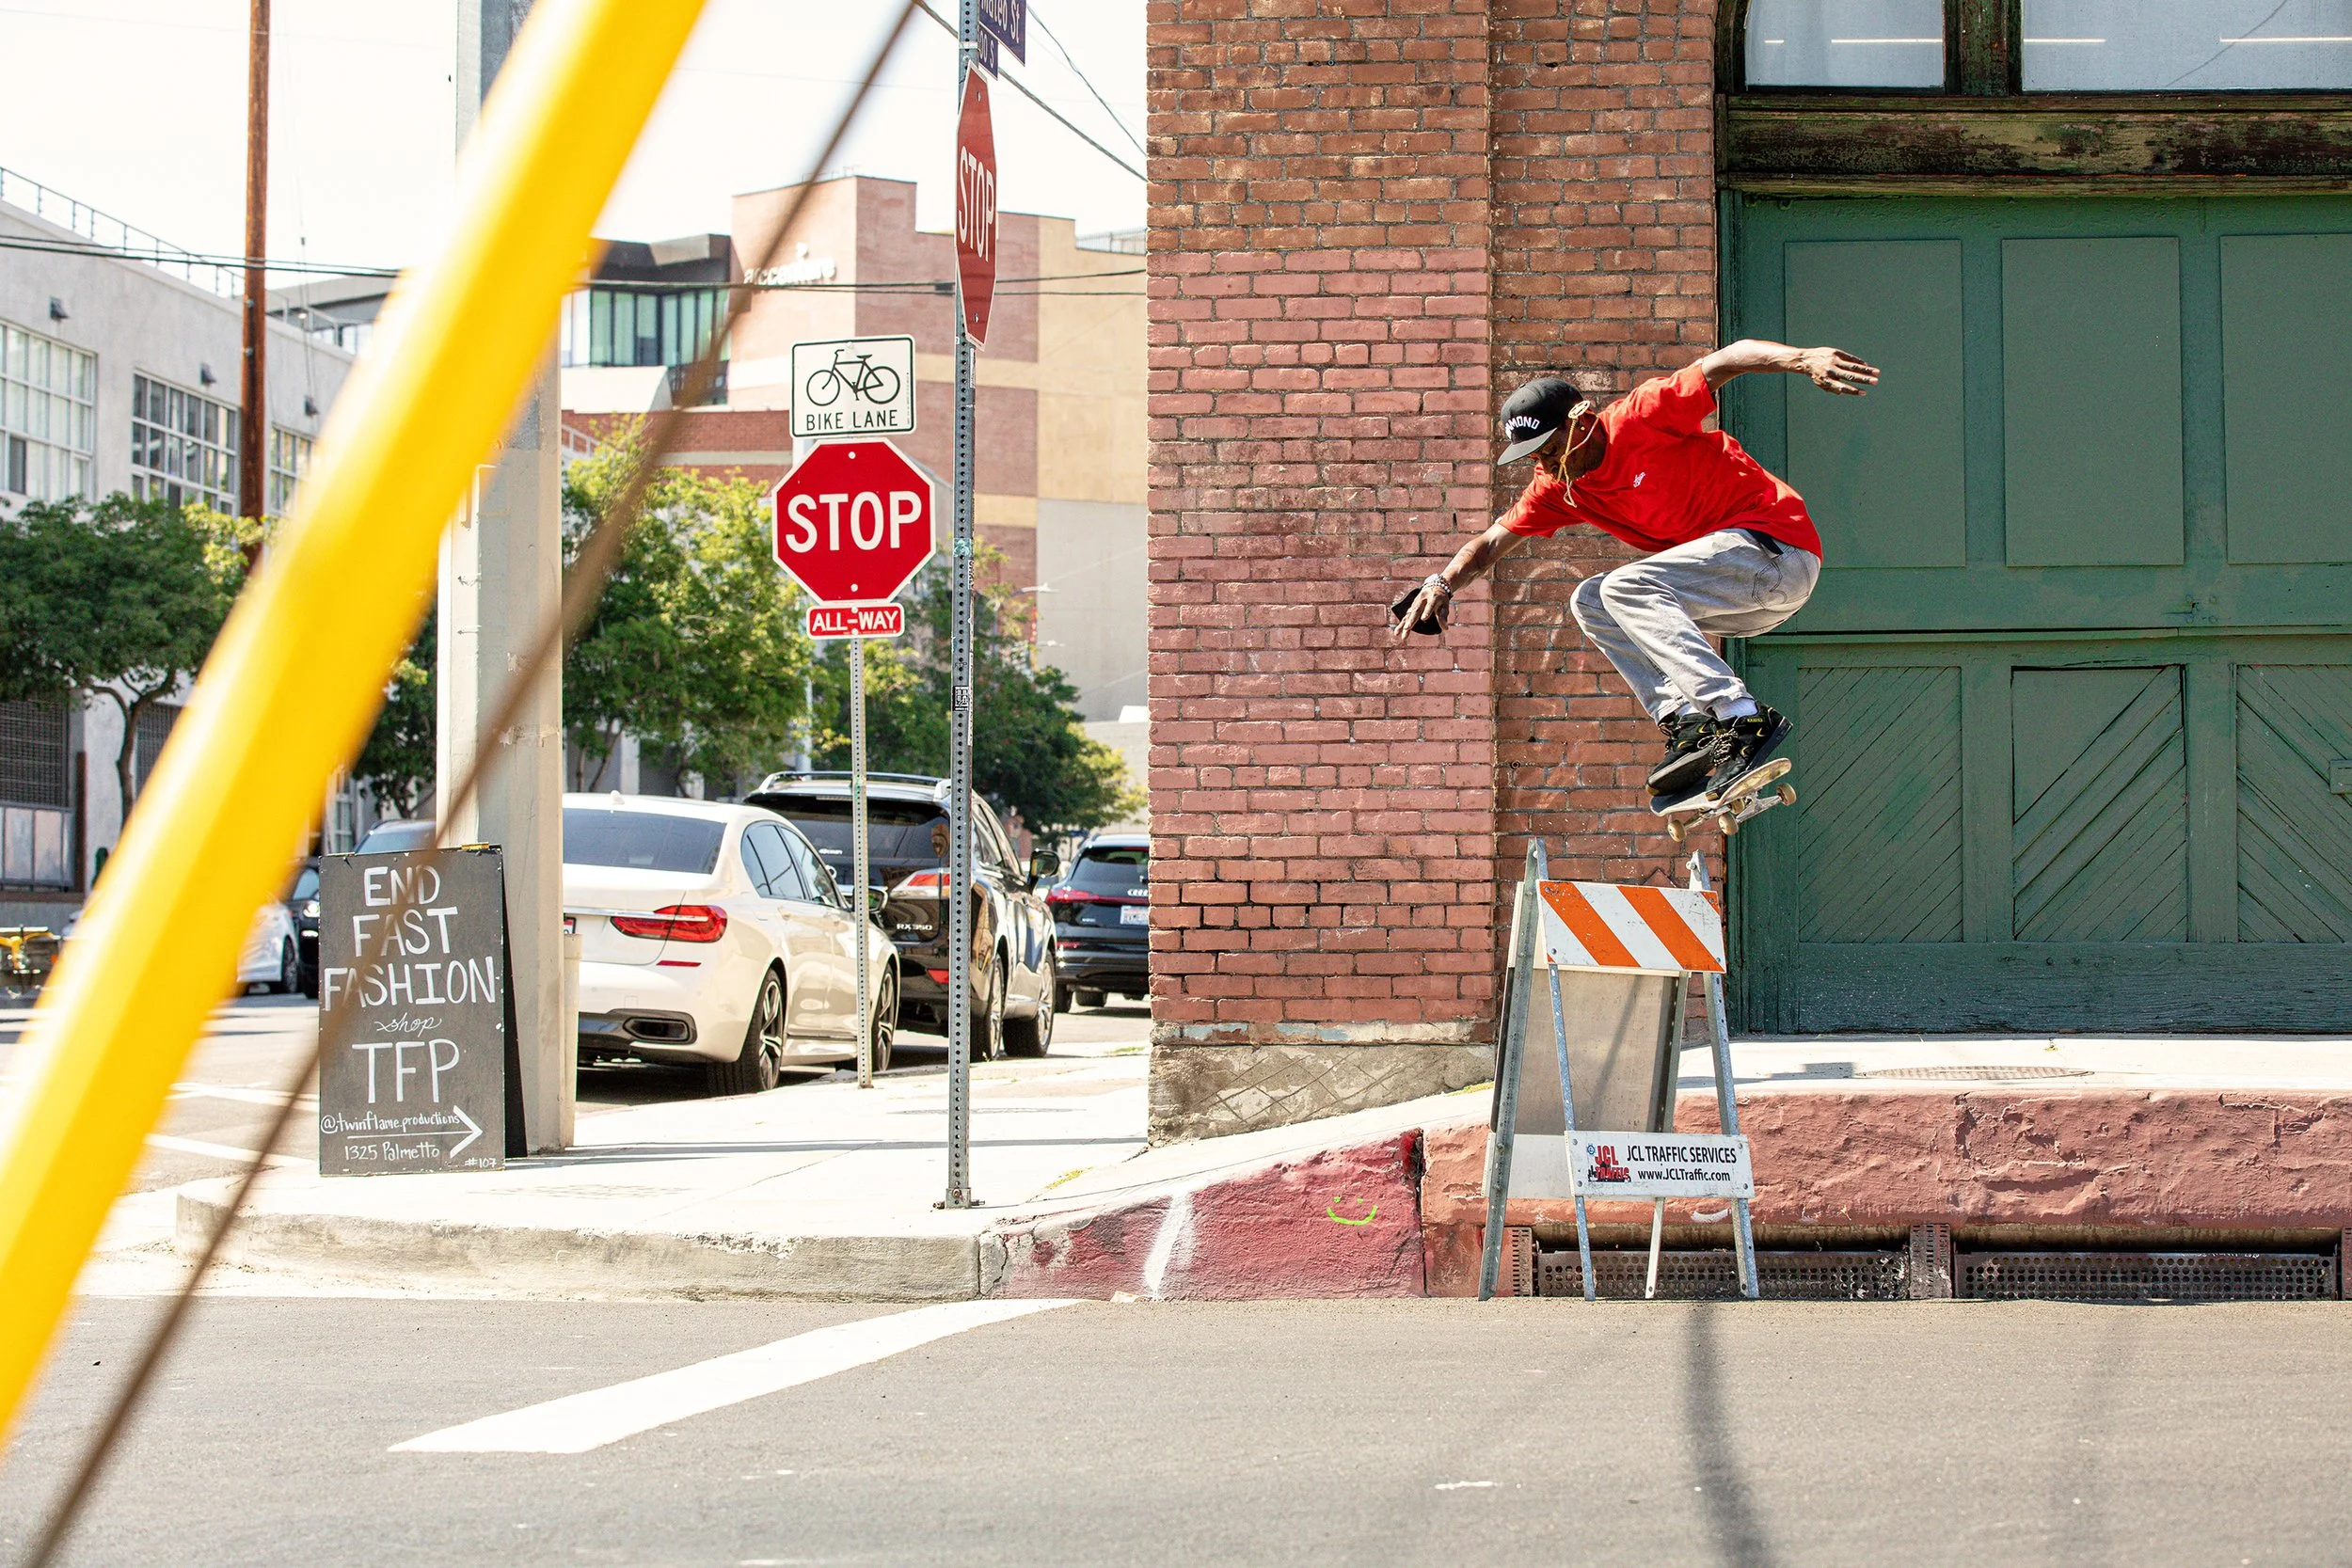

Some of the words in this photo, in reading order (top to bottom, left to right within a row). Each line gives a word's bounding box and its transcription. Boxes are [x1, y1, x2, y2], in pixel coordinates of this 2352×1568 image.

[979, 0, 1008, 31] ateo
[1010, 0, 1020, 44] St
[989, 40, 994, 69] S
[959, 146, 994, 262] STOP
[806, 412, 844, 431] BIKE
[852, 409, 898, 428] LANE
[786, 491, 922, 553] STOP
[812, 610, 898, 632] ALL-WAY
[364, 865, 441, 907] END
[353, 907, 458, 958] FAST
[324, 956, 496, 1011] FASHION
[374, 1012, 442, 1037] shop
[352, 1038, 460, 1104] TFP
[320, 1111, 461, 1134] @twinflame.productions
[344, 1144, 377, 1161] 1325
[382, 1141, 440, 1162] Palmetto
[465, 1158, 497, 1168] #107
[1595, 1145, 1619, 1165] JCL
[1627, 1145, 1645, 1162] JCL
[1645, 1146, 1688, 1163] TRAFFIC
[1690, 1147, 1737, 1164] SERVICES
[1637, 1167, 1731, 1181] www.JCLTraffic.com
